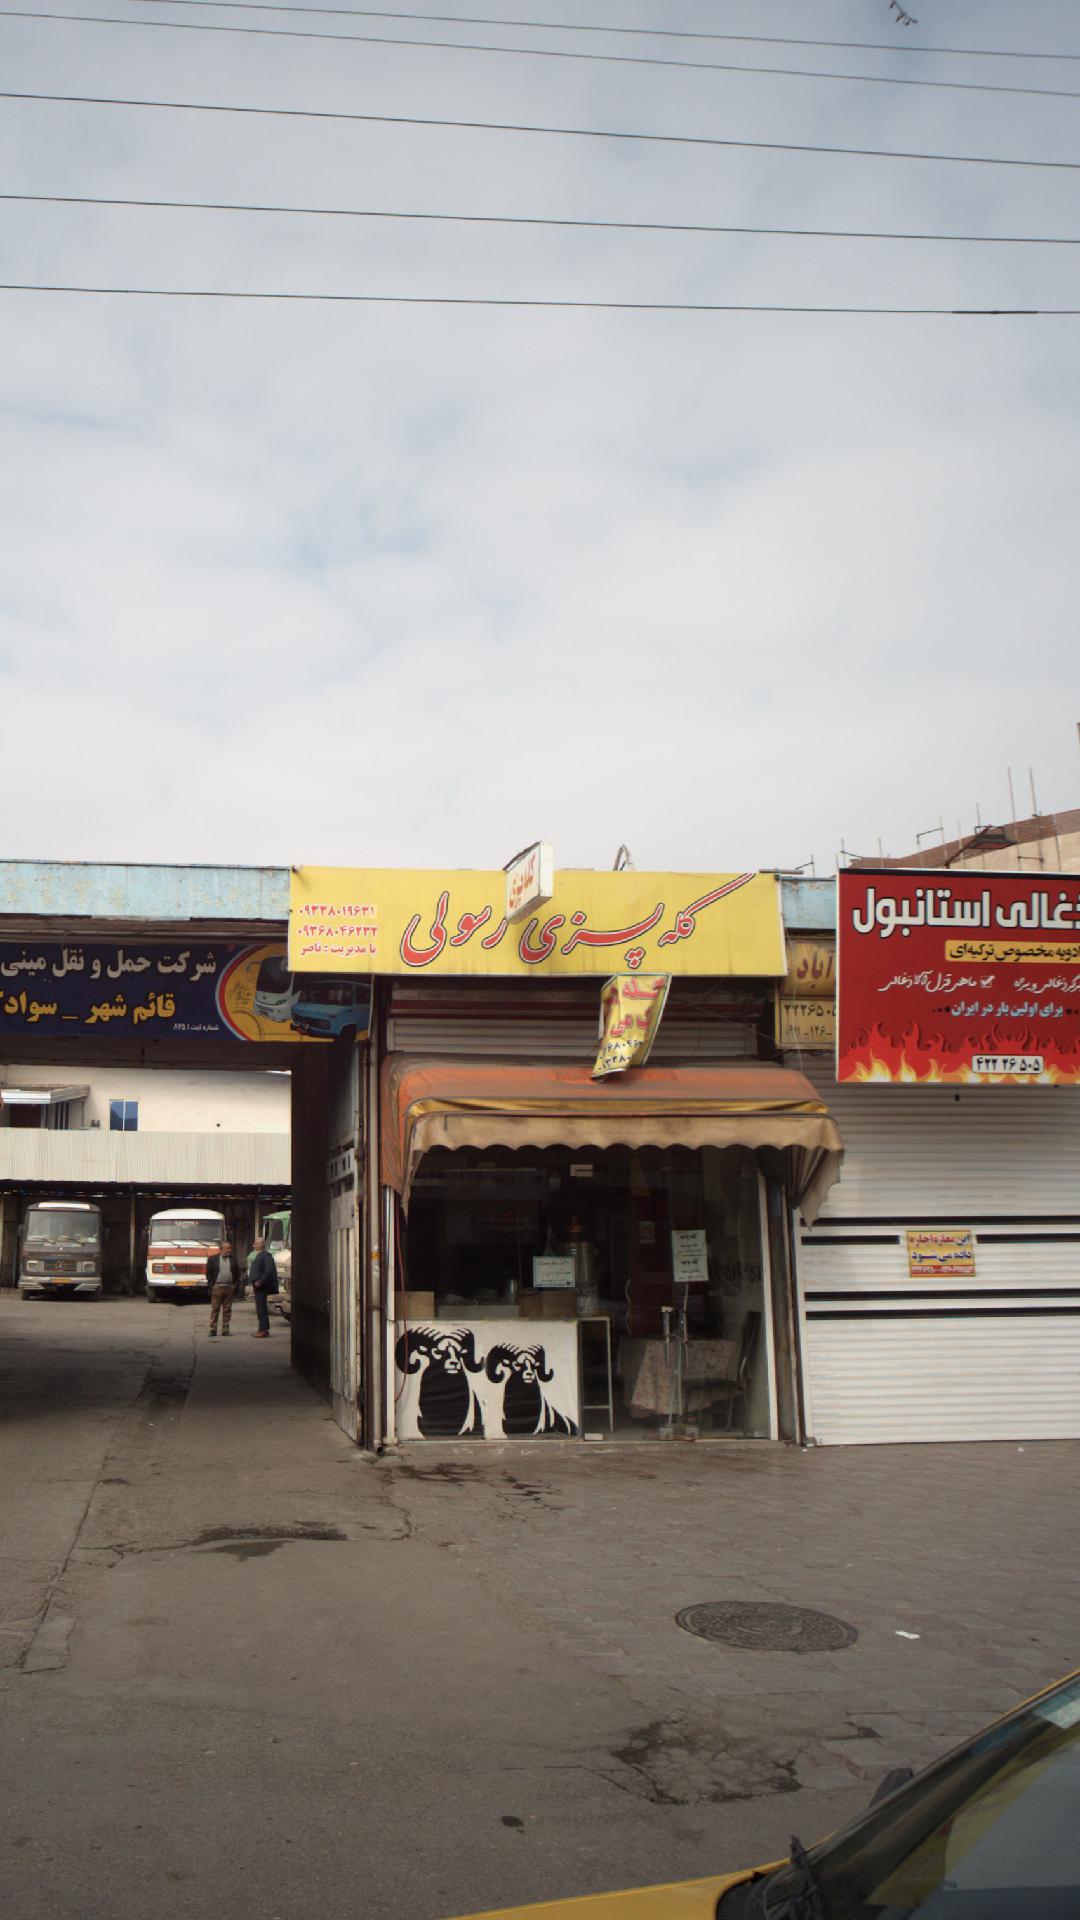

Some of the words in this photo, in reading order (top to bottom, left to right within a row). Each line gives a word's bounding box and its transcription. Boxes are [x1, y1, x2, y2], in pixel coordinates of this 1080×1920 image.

[658, 872, 756, 947] کله
[852, 886, 991, 938] استانبول
[995, 891, 1080, 930] غالی
[400, 890, 508, 967] رسولی
[0, 950, 47, 977] مینی
[52, 948, 84, 978] نقل
[89, 958, 101, 979] و
[107, 949, 152, 979] حمل
[158, 951, 217, 981] شرکت
[995, 946, 1054, 962] مخصوص
[0, 990, 58, 1022] سواد
[85, 994, 127, 1024] شهر
[133, 992, 176, 1025] قائم
[951, 1000, 979, 1016] ایران
[981, 1003, 993, 1017] در
[996, 1001, 1009, 1017] بار
[1010, 1001, 1038, 1017] اولین
[1040, 1002, 1064, 1017] برای
